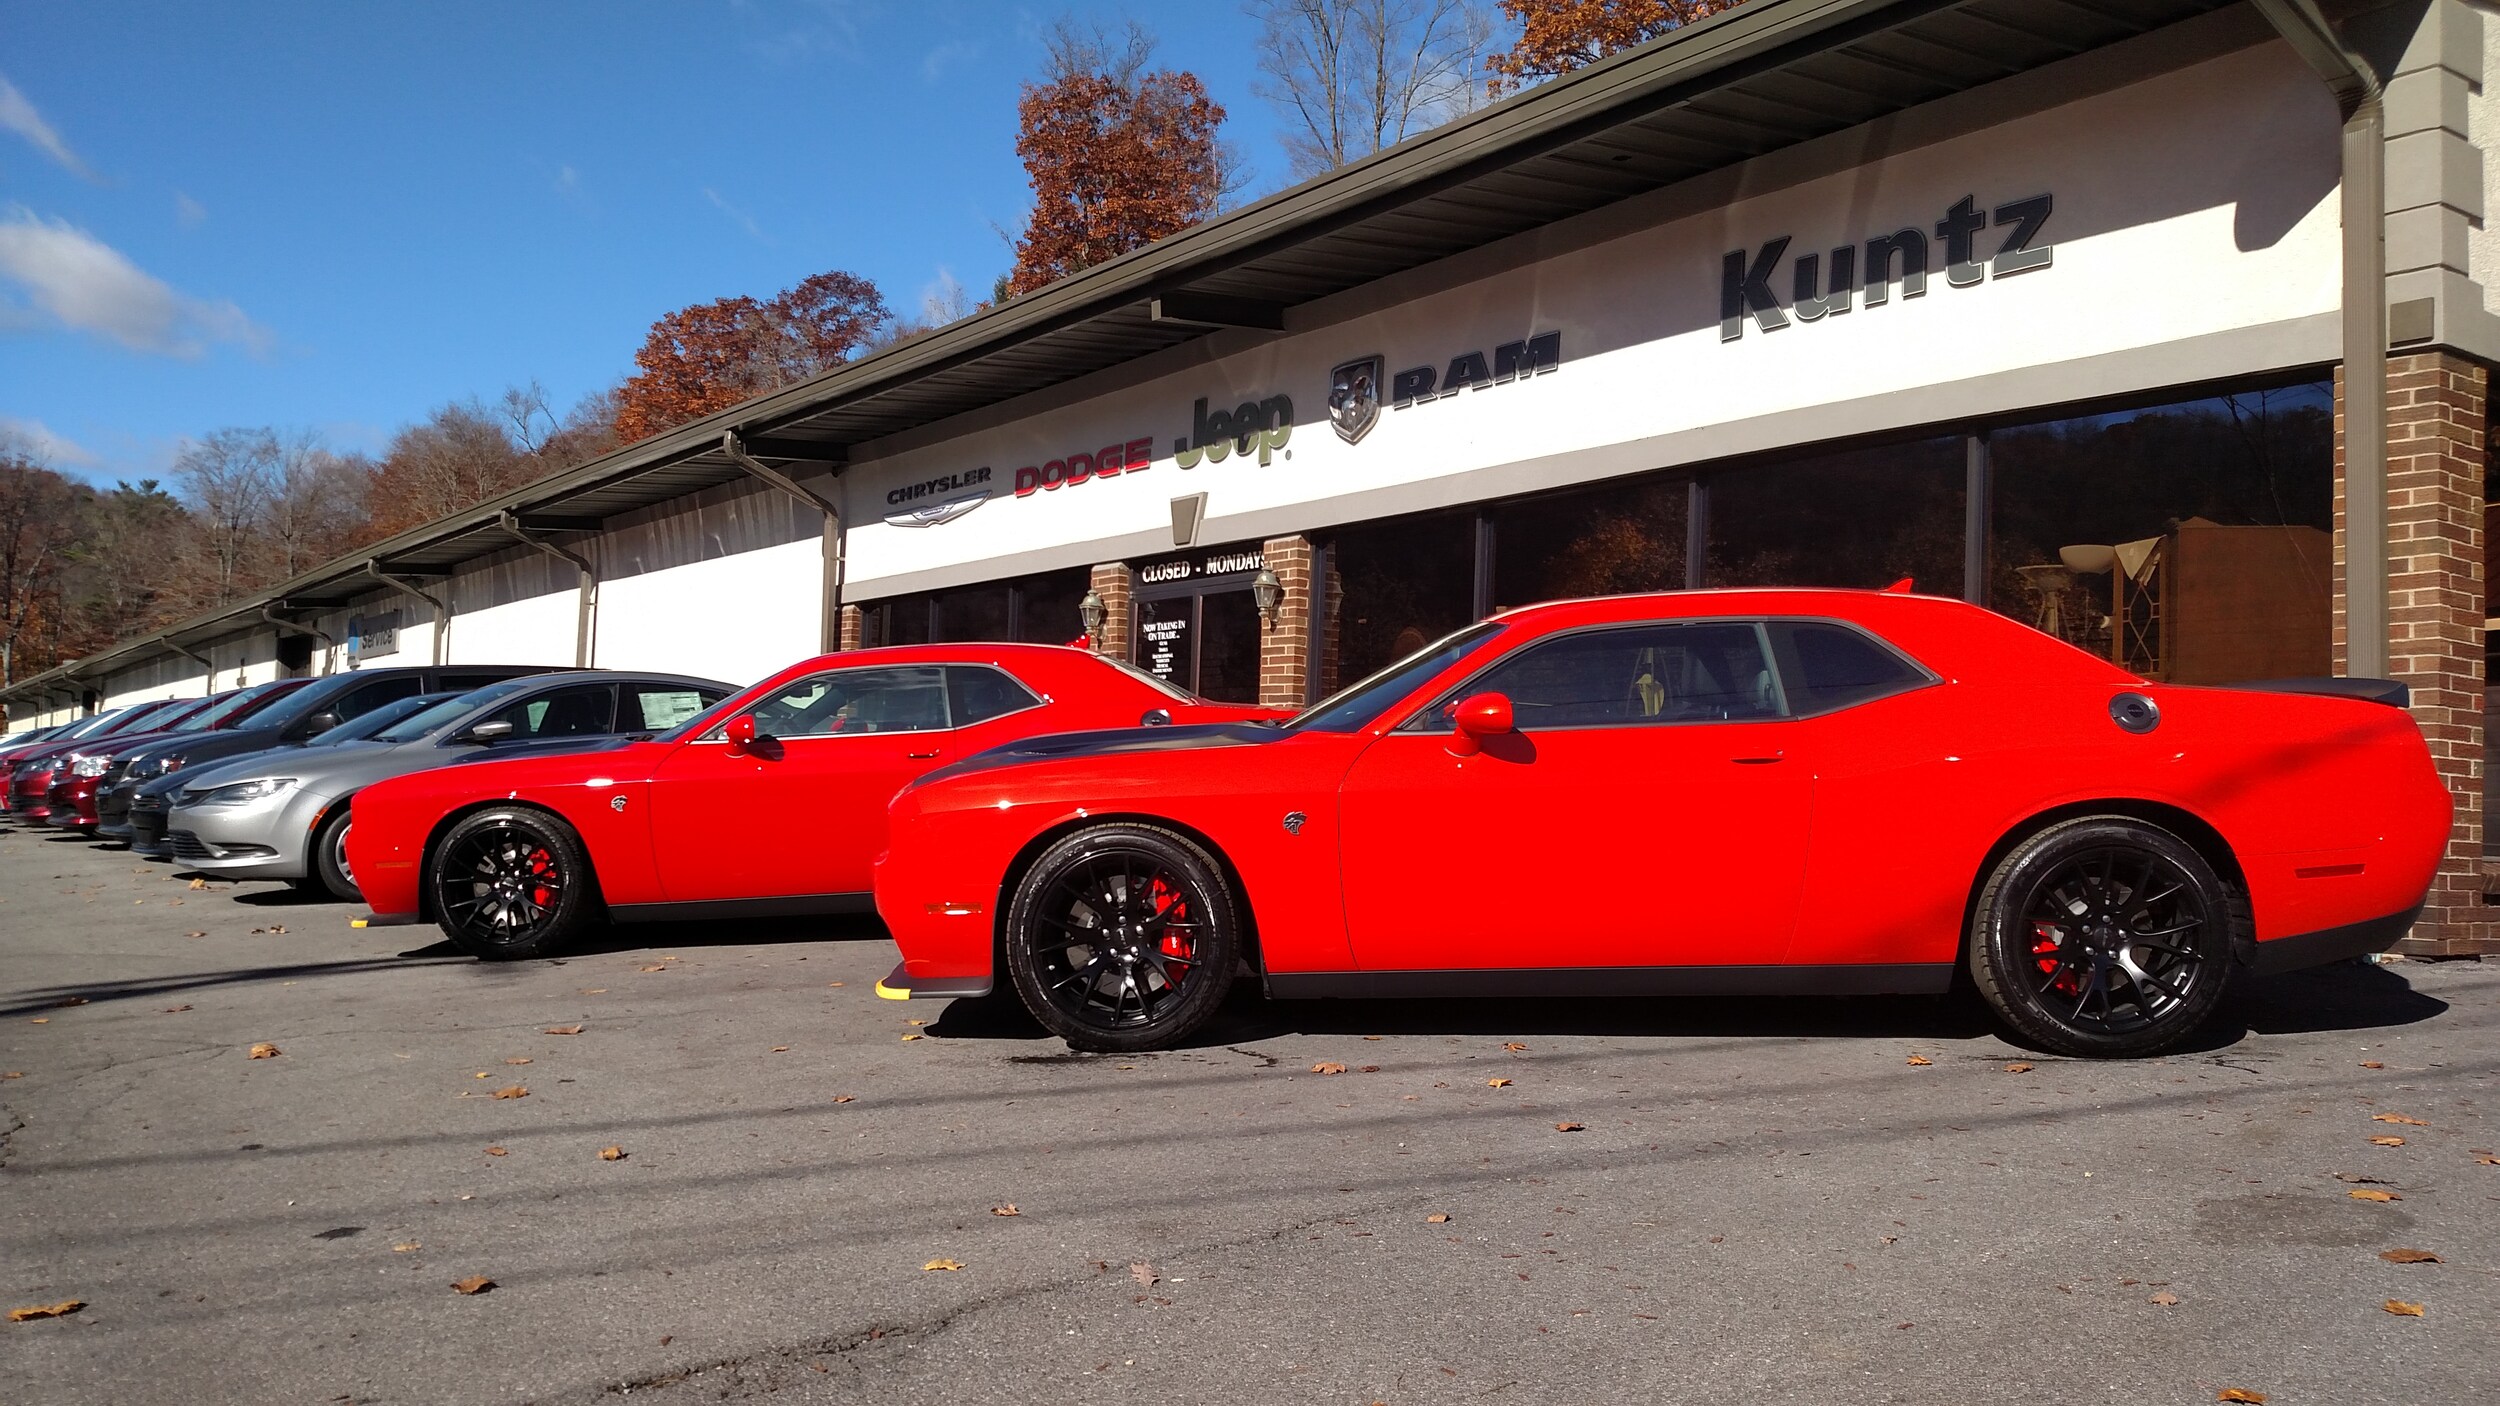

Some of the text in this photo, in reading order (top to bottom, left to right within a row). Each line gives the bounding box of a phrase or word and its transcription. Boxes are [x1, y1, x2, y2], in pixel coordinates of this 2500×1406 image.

[1719, 193, 2053, 344] Kuntz
[1392, 331, 1561, 411] RAM
[1174, 393, 1294, 470] Jeep
[886, 466, 992, 505] CHRYSLER
[1014, 436, 1153, 499] DODGE
[1142, 561, 1191, 583] CLOSED
[362, 627, 393, 650] Service
[1143, 619, 1186, 633] NOW TAKING IN
[1147, 632, 1158, 641] ON
